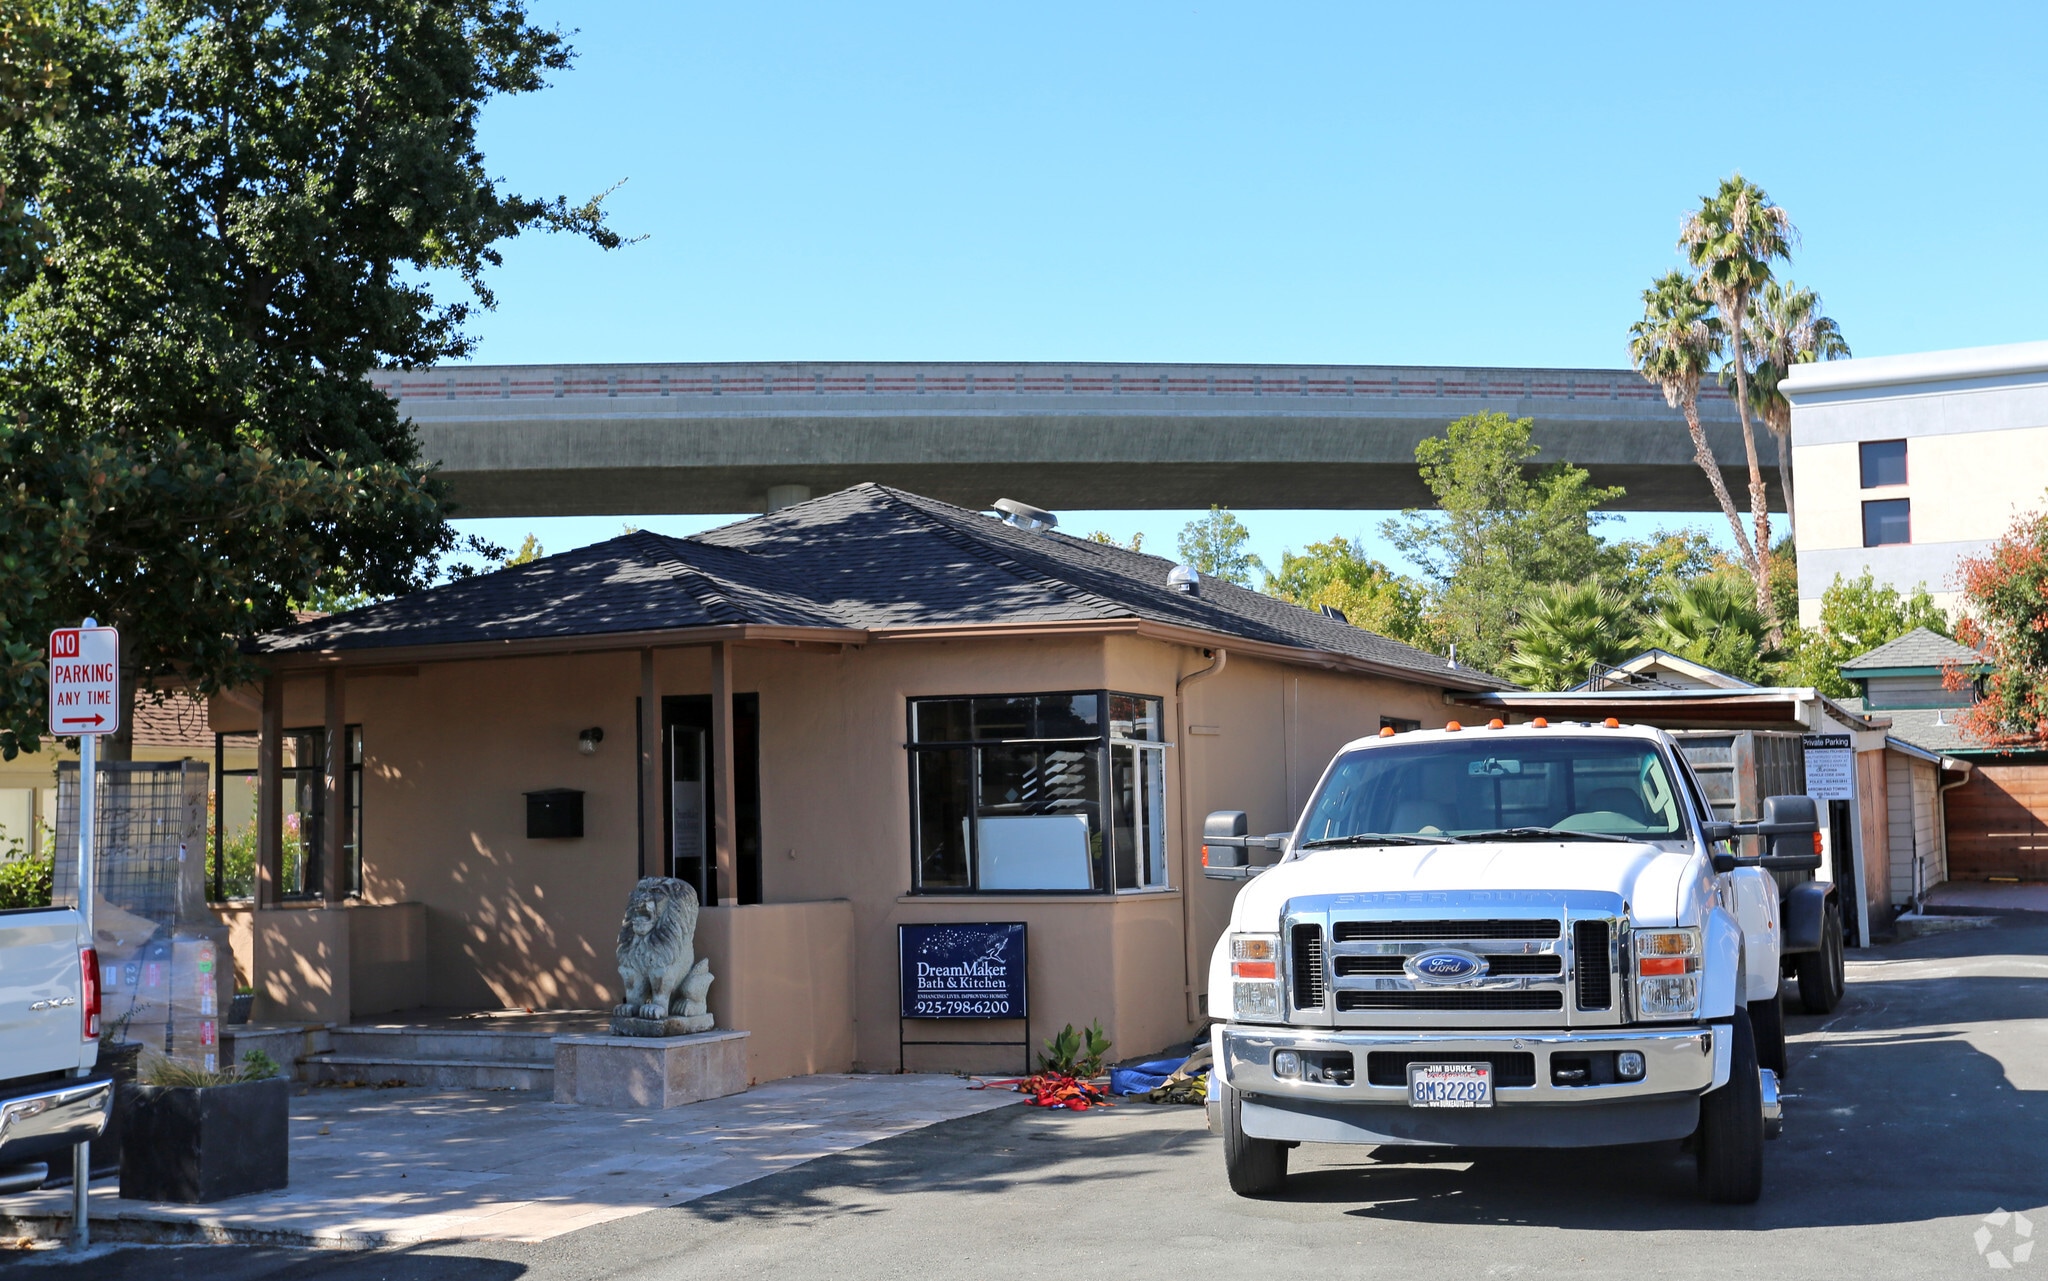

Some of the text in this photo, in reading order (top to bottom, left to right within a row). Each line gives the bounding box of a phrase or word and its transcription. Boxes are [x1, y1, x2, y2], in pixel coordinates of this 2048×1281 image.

[55, 633, 76, 655] NO
[55, 663, 113, 684] PARKING
[57, 690, 111, 706] ANY TIME
[1825, 738, 1848, 747] Parking
[1334, 892, 1448, 905] SUPER
[917, 961, 1007, 977] DreamMaker
[1428, 958, 1461, 973] Ford
[917, 977, 1007, 989] Bath & Kitchen
[917, 1001, 1009, 1014] 925-798-6200
[1428, 1064, 1472, 1073] JIM BURKE
[1415, 1081, 1487, 1101] 8M32289
